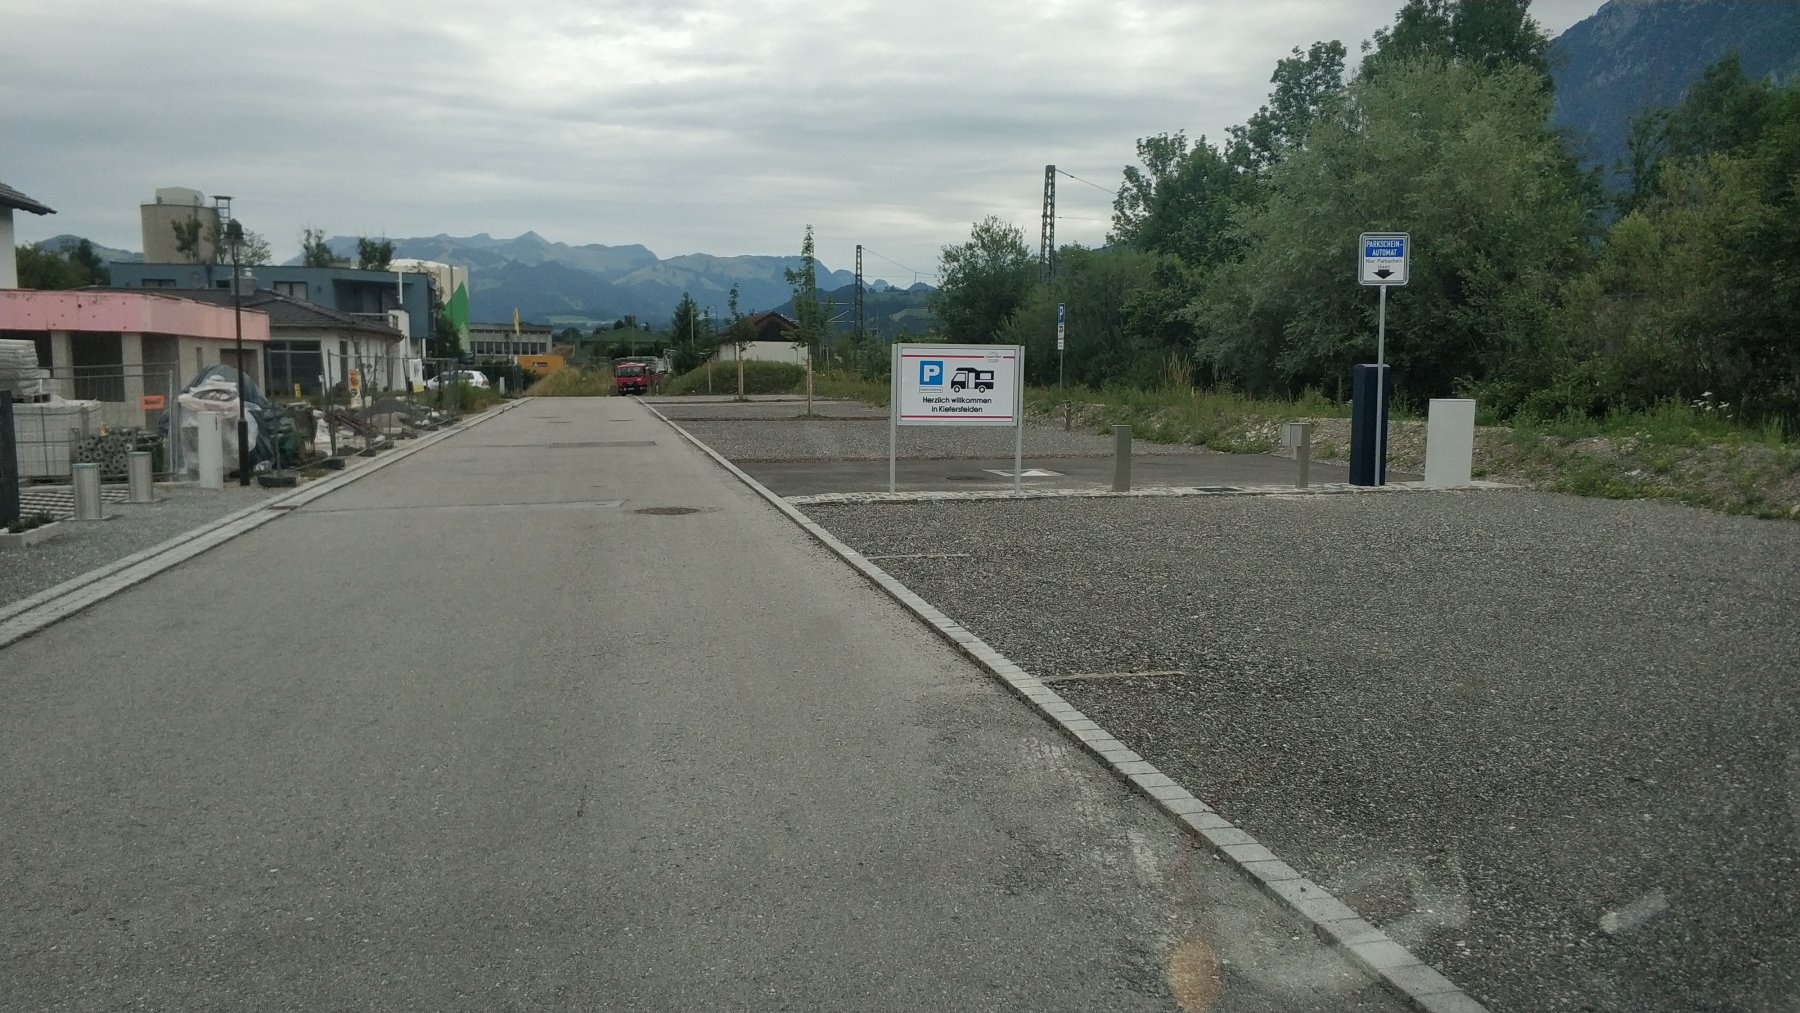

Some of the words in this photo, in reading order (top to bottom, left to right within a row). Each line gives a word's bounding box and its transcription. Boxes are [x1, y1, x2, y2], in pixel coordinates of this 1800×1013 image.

[923, 365, 940, 382] P
[922, 396, 950, 404] Herzlich
[951, 396, 992, 404] willkommen
